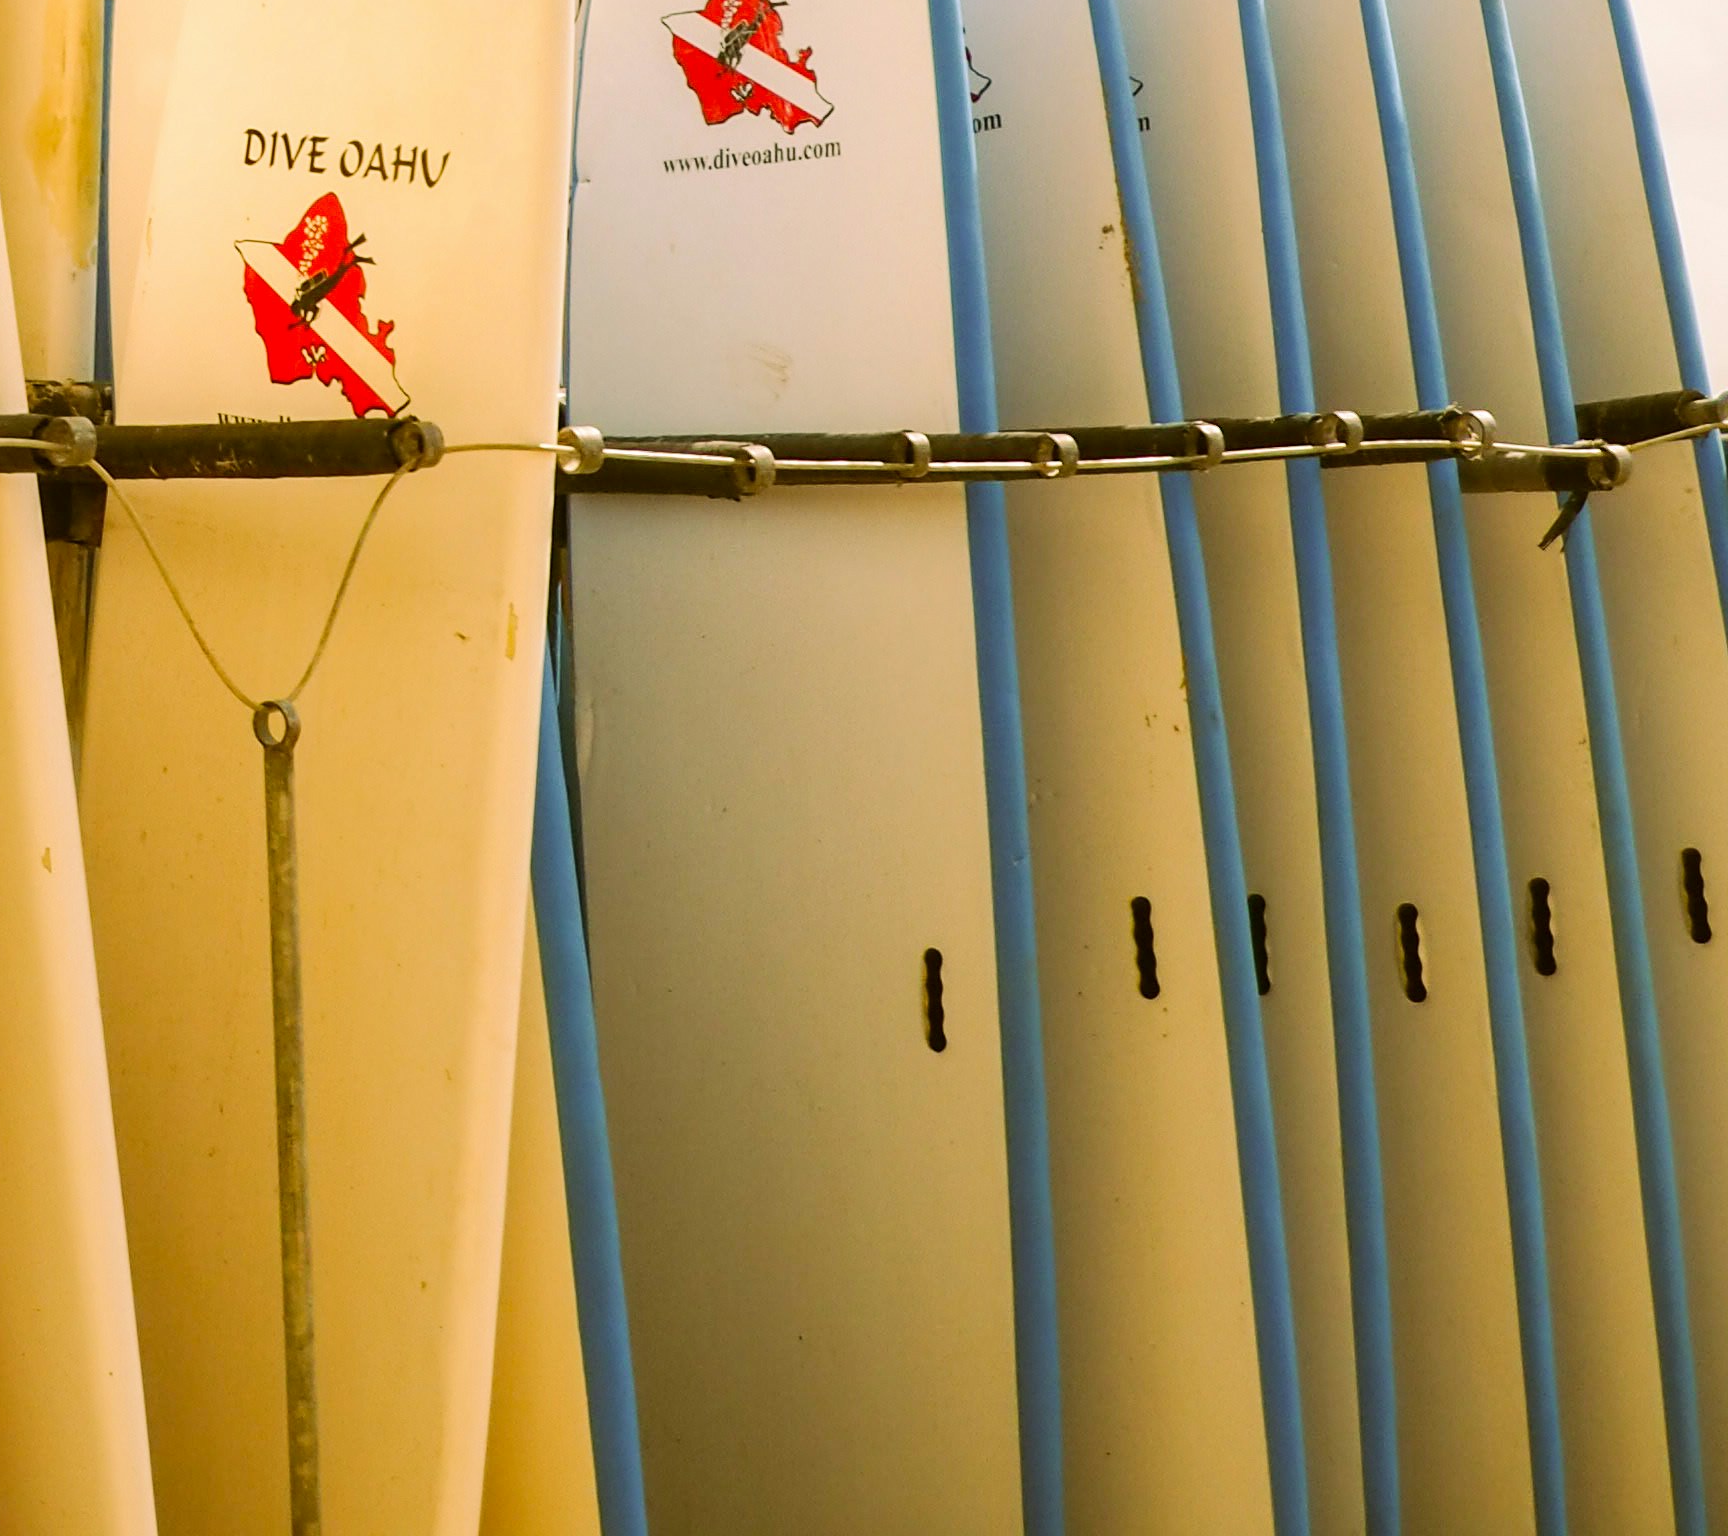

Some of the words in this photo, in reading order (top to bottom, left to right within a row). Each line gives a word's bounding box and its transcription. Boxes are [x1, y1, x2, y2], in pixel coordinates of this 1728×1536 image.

[244, 128, 330, 174] DIVE
[340, 140, 450, 188] OAHU
[663, 138, 842, 174] www.diveoahu.com
